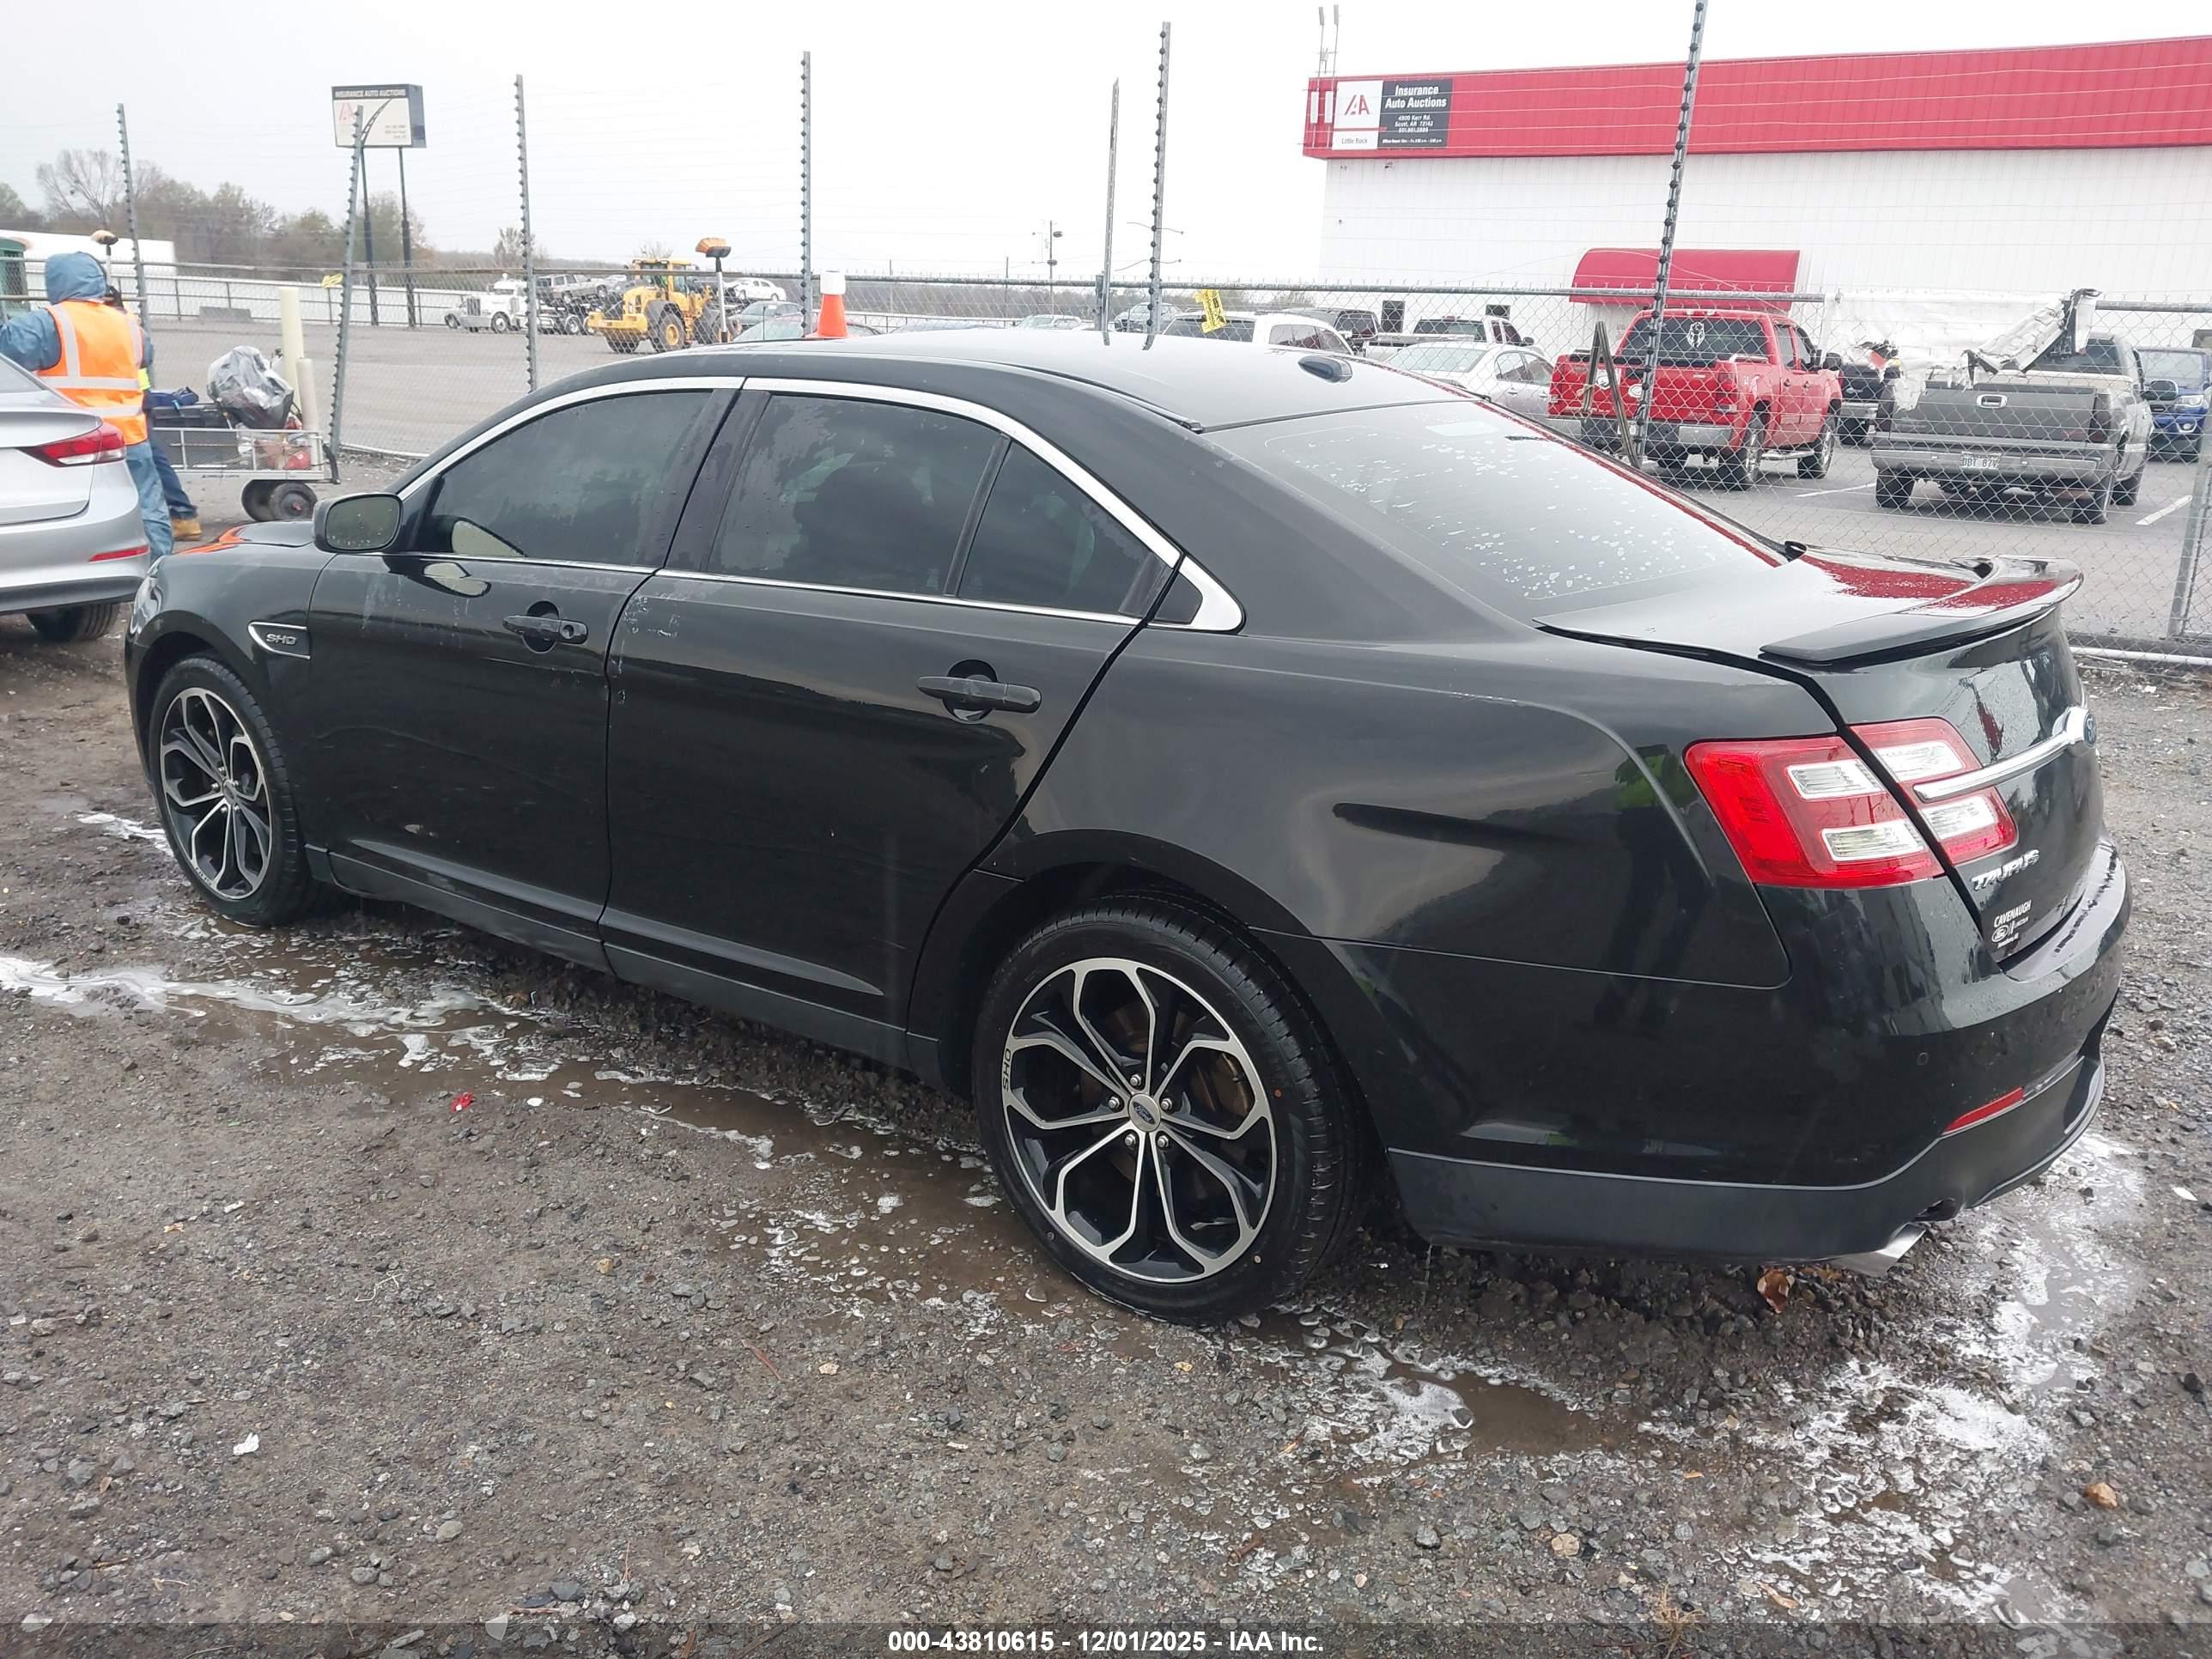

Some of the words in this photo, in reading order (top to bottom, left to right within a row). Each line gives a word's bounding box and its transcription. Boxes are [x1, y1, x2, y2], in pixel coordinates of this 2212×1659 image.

[1395, 85, 1439, 96] Insurance
[1385, 98, 1406, 109] Auto
[1407, 96, 1447, 108] Auctions
[266, 633, 297, 645] SHO
[1971, 848, 2041, 890] TAURUS
[1993, 899, 2032, 928] CAVENAUGH
[1003, 1048, 1012, 1092] SHO
[1134, 1104, 1153, 1123] Ford
